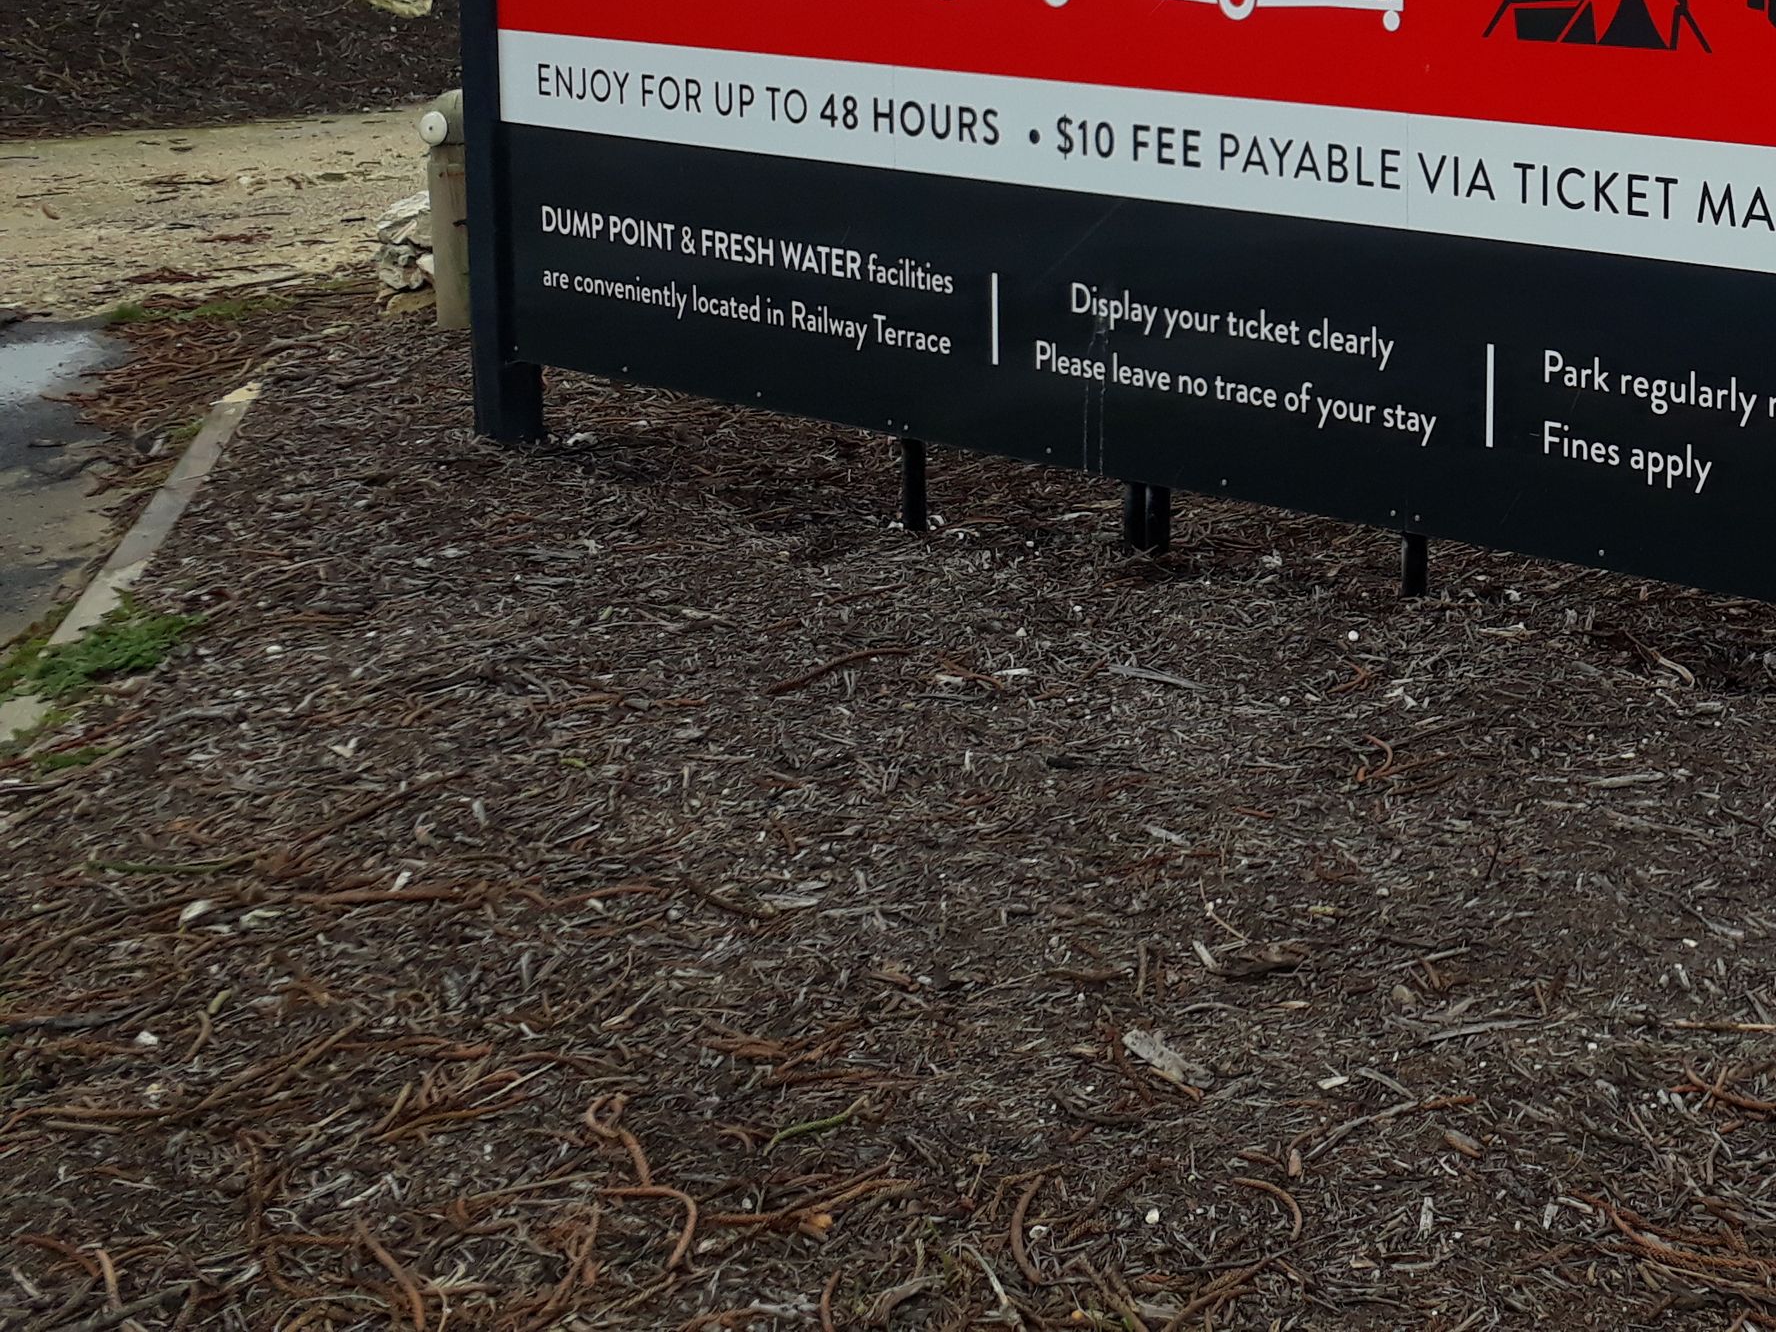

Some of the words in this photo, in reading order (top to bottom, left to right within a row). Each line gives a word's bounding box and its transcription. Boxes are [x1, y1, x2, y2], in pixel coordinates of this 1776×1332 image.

[537, 62, 631, 105] ENJOY
[641, 73, 702, 113] FOR
[714, 81, 755, 118] UP
[765, 87, 808, 124] TO
[819, 93, 859, 130] 48
[873, 97, 1000, 146] HOURS
[1056, 114, 1115, 161] $10
[1132, 123, 1201, 168] FEE
[1219, 132, 1401, 190] PAYABLE
[1417, 152, 1496, 201] VIA
[1513, 162, 1678, 220] TICKET
[541, 204, 604, 239] DUMP
[608, 214, 675, 252] POINT
[680, 226, 696, 256] &
[700, 229, 774, 268] FRESH
[780, 239, 862, 281] WATER
[867, 253, 954, 295] facilities
[542, 267, 570, 291] are
[574, 274, 687, 319] conveniently
[692, 284, 761, 324] located
[766, 297, 785, 327] in
[791, 301, 868, 352] Railway
[873, 313, 952, 355] Terrace
[1071, 281, 1158, 336] Display
[1163, 305, 1220, 339] your
[1226, 309, 1301, 346] ticket
[1307, 317, 1395, 371] clearly
[1035, 339, 1106, 381] Please
[1112, 352, 1171, 392] leave
[1178, 372, 1208, 397] no
[1214, 374, 1278, 409] trace
[1284, 382, 1313, 414] of
[1316, 392, 1376, 428] your
[1383, 403, 1437, 446] stay
[1543, 348, 1610, 393] Park
[1620, 370, 1758, 427] regularly
[1542, 420, 1621, 466] Fines
[1629, 443, 1713, 494] apply
